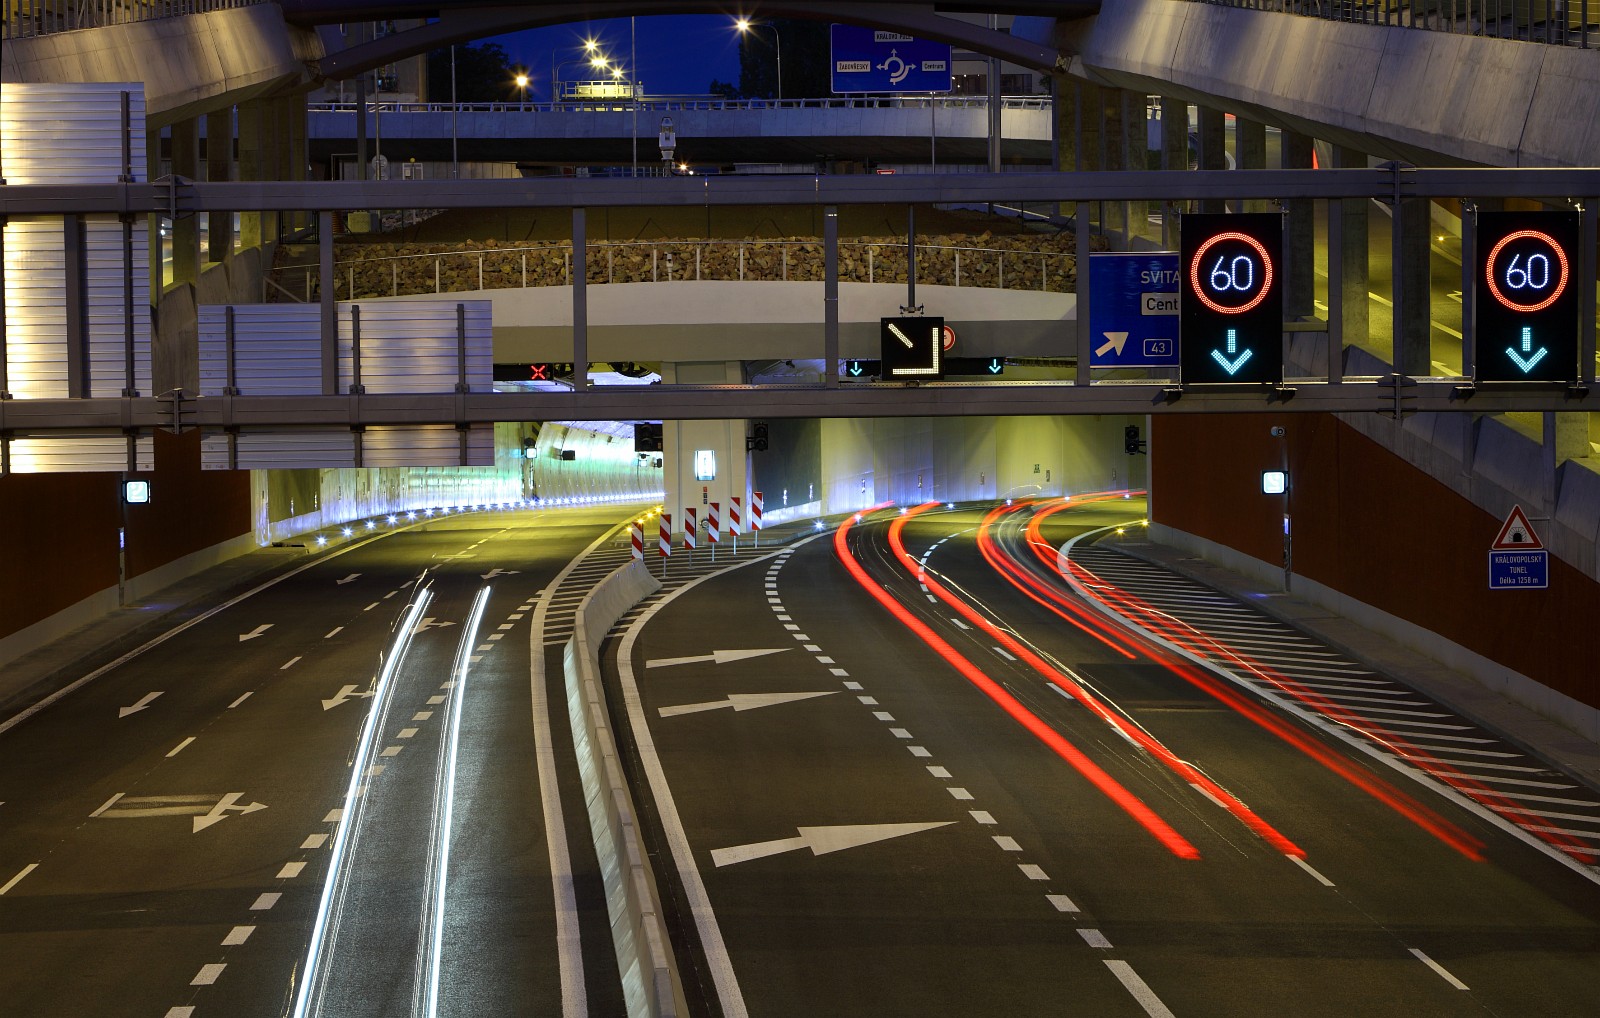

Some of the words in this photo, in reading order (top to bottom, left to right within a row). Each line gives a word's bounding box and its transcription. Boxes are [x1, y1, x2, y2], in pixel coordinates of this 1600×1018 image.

[1211, 255, 1253, 291] 60
[1506, 253, 1549, 289] 60
[1146, 297, 1178, 311] Cent
[1151, 342, 1166, 354] 43
[1495, 554, 1542, 564] KRÁLOVOPOLSKÝ
